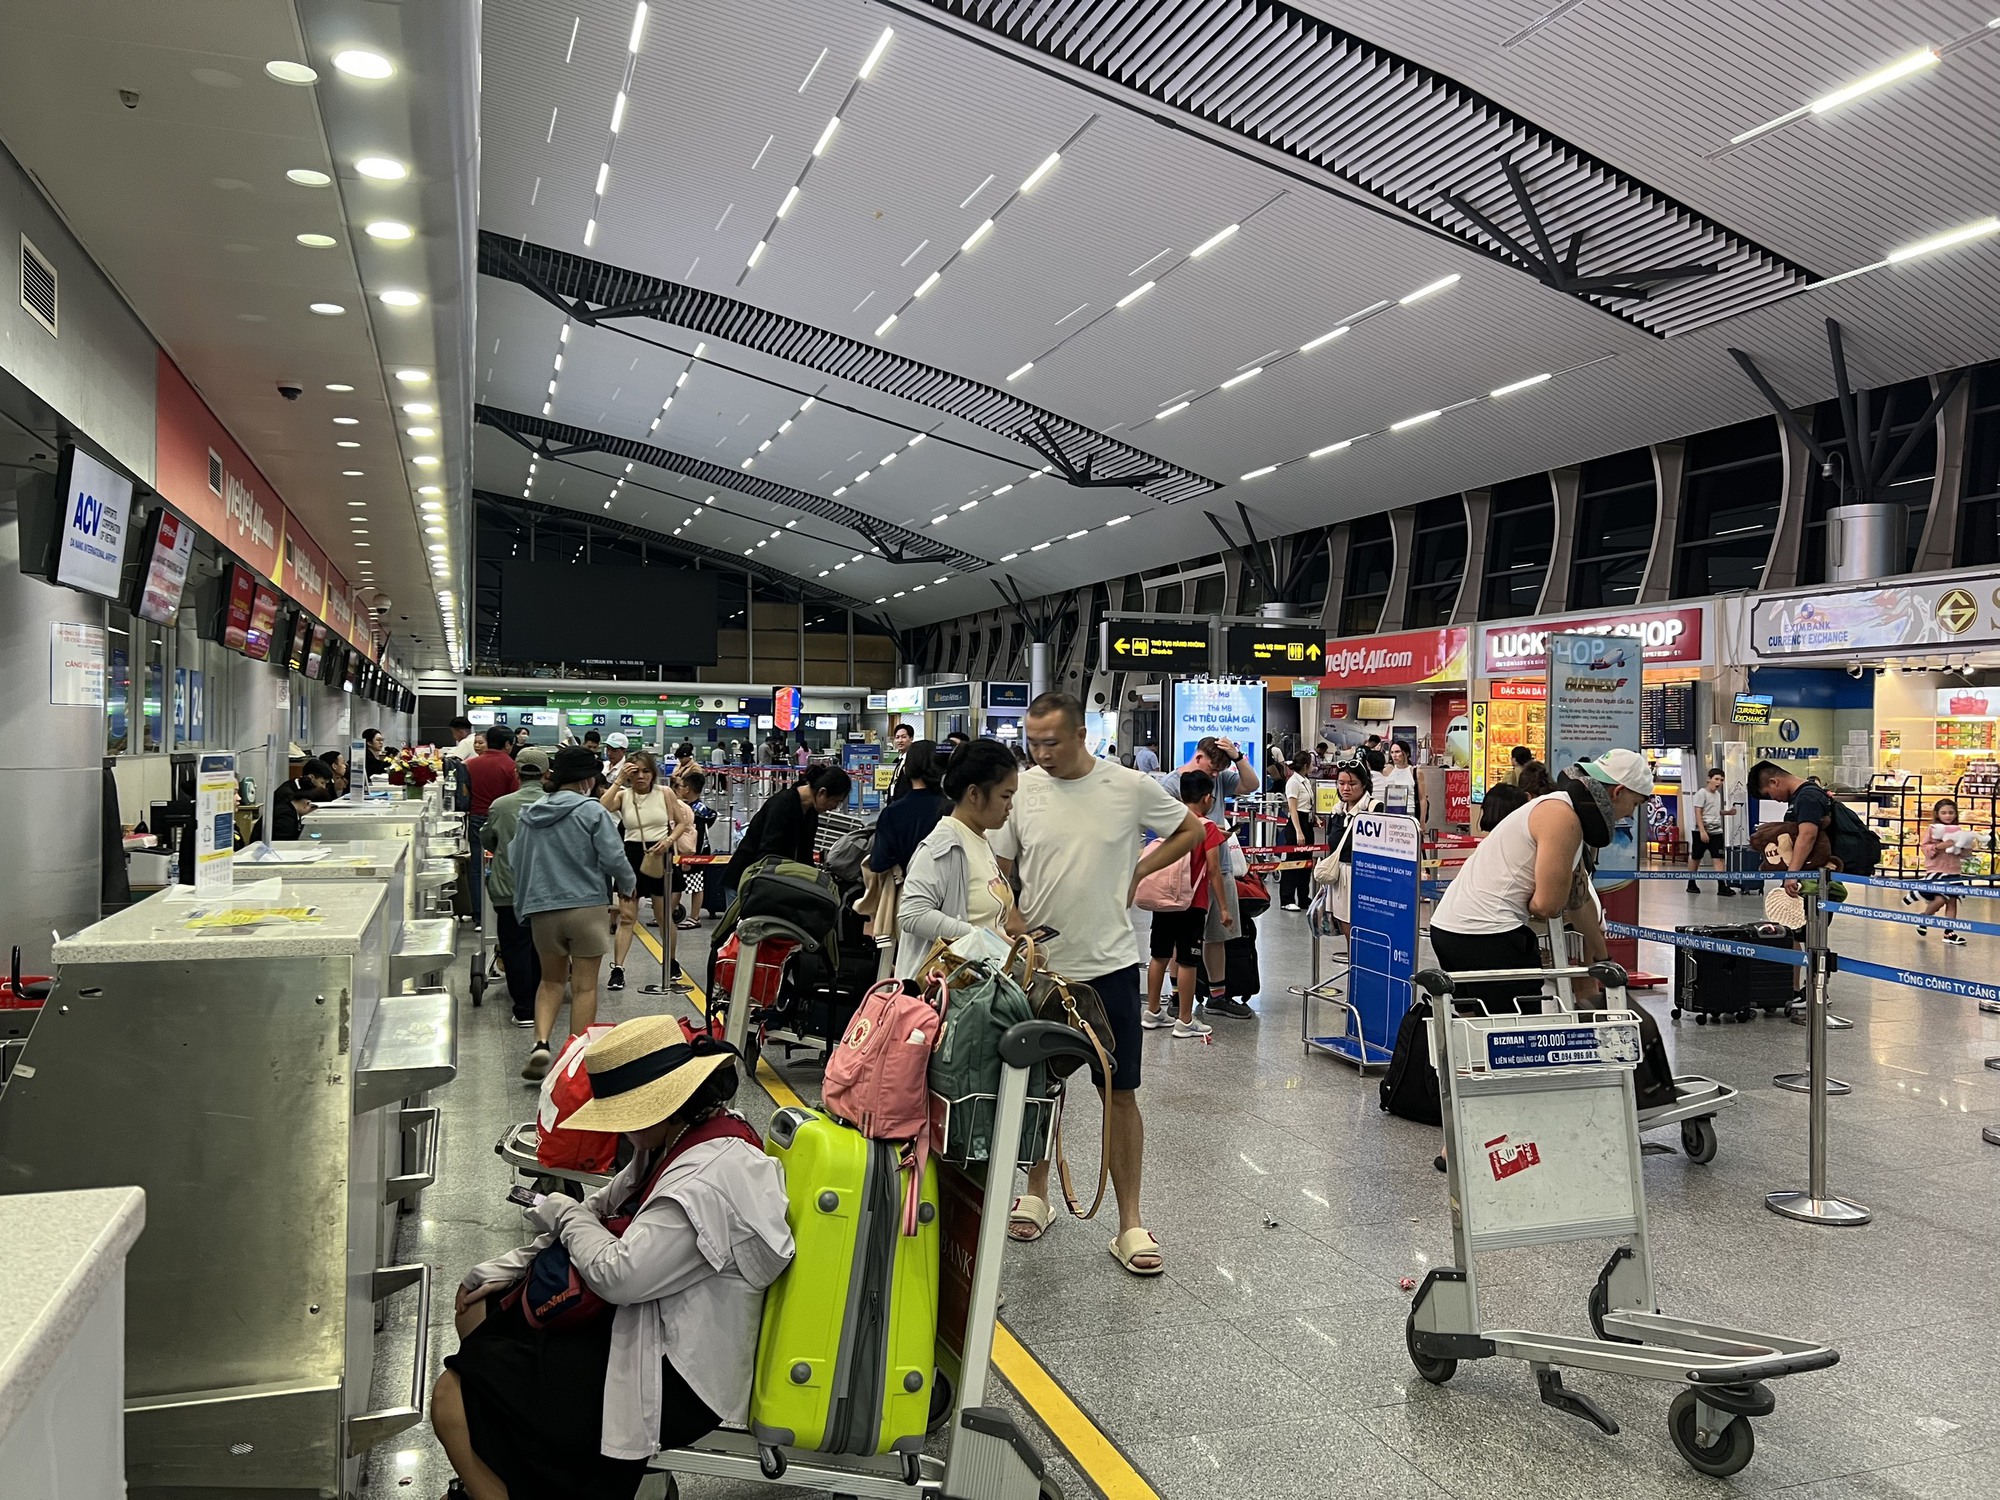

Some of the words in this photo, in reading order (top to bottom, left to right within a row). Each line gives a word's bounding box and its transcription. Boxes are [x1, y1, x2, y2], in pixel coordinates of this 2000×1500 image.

[73, 492, 103, 536] ACV
[1784, 621, 1831, 634] EXIMBANK
[1768, 634, 1807, 647] CURRENCY
[1807, 631, 1848, 645] EXCHANGE
[1501, 686, 1515, 695] ĐẶC
[1516, 685, 1531, 695] SẢN
[1531, 685, 1542, 695] ĐÀ
[1565, 677, 1617, 693] BUSINESS
[192, 686, 203, 726] 24
[1735, 706, 1768, 716] CURRENCY
[495, 715, 506, 723] 41
[521, 715, 533, 723] 42
[593, 716, 605, 724] 43
[715, 718, 726, 726] 46
[805, 719, 815, 728] 48
[1183, 714, 1199, 722] CHI
[1200, 712, 1217, 722] TIÊU
[1241, 712, 1255, 723] GIÁ
[1735, 715, 1767, 723] EXCHANGE
[1219, 724, 1232, 733] Việt
[1756, 747, 1820, 759] EXIMBANK
[1356, 820, 1382, 838] ACV
[1389, 824, 1408, 832] AIRPORTS
[1389, 830, 1415, 839] CORPORATION
[1674, 872, 1691, 880] CẢNG
[1728, 872, 1742, 880] VIỆT
[1868, 877, 1884, 886] TỔNG
[1885, 879, 1901, 888] CÔNG
[1910, 882, 1927, 891] CẢNG
[1927, 884, 1945, 893] HÀNG
[1946, 885, 1968, 895] KHÔNG
[1984, 888, 1999, 897] NAM
[1357, 893, 1370, 902] CABIN
[1369, 896, 1388, 906] BAGGAGE
[1388, 900, 1398, 908] TEST
[1398, 902, 1408, 910] UNIT
[1838, 905, 1872, 917] AIRPORTS
[1873, 908, 1924, 924] CORPORATION
[1925, 916, 1936, 925] OF
[1936, 918, 1972, 930] VIETNAM
[1613, 923, 1630, 936] CÔNG
[1630, 928, 1639, 937] TY
[1657, 930, 1676, 944] HÀNG
[1676, 934, 1700, 948] KHÔNG
[1716, 941, 1731, 953] NAM
[1737, 945, 1756, 957] CTCP
[1393, 949, 1401, 962] 01
[1897, 971, 1924, 986] TỔNG
[1925, 975, 1951, 991] CÔNG
[1953, 983, 1967, 994] TY
[1967, 983, 1996, 999] CẢNG
[1493, 1035, 1525, 1046] BIZMAN
[1537, 1034, 1566, 1048] 20.000
[1495, 1055, 1507, 1065] LIÊN
[1508, 1055, 1515, 1065] HỆ
[1534, 1053, 1545, 1062] CÁO
